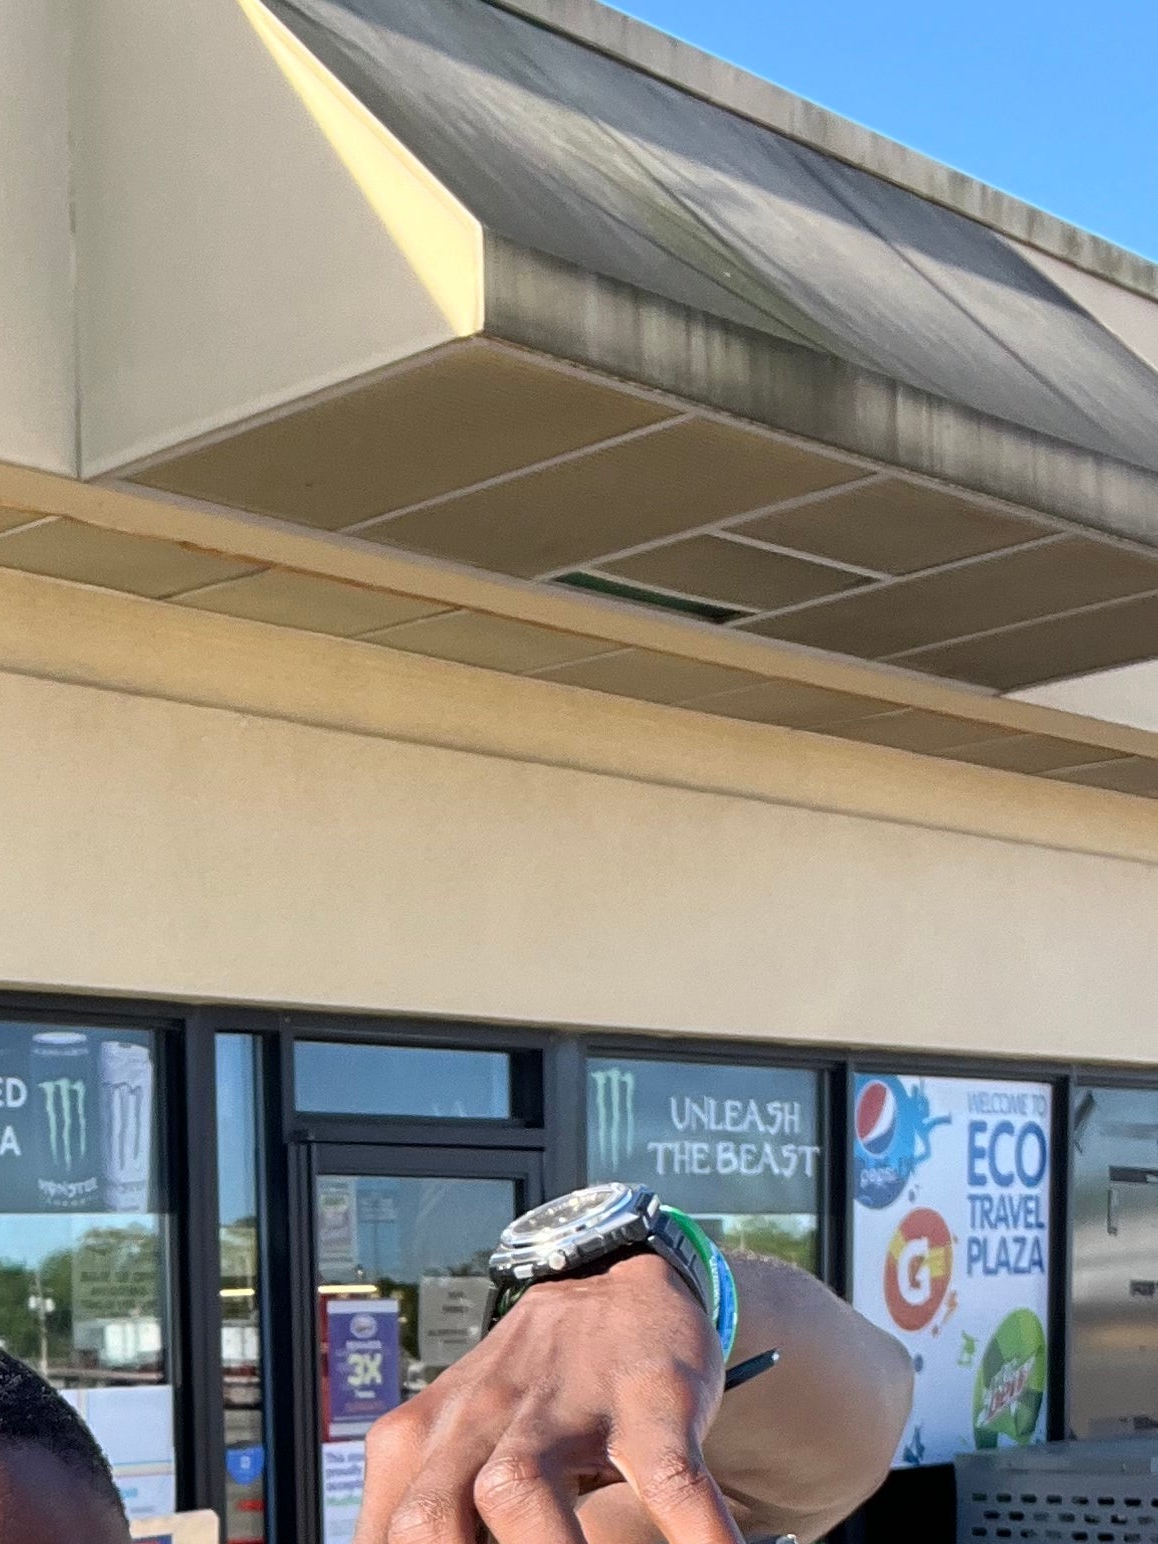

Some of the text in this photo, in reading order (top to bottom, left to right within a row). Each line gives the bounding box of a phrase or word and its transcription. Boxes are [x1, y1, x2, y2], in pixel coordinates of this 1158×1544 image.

[669, 1095, 802, 1135] UNLEASH
[967, 1091, 1048, 1115] WELCOME TO
[647, 1140, 821, 1179] THE BEAST
[967, 1119, 1048, 1188] ECO
[967, 1193, 1045, 1230] TRAVEL
[967, 1235, 1045, 1276] PLAZA
